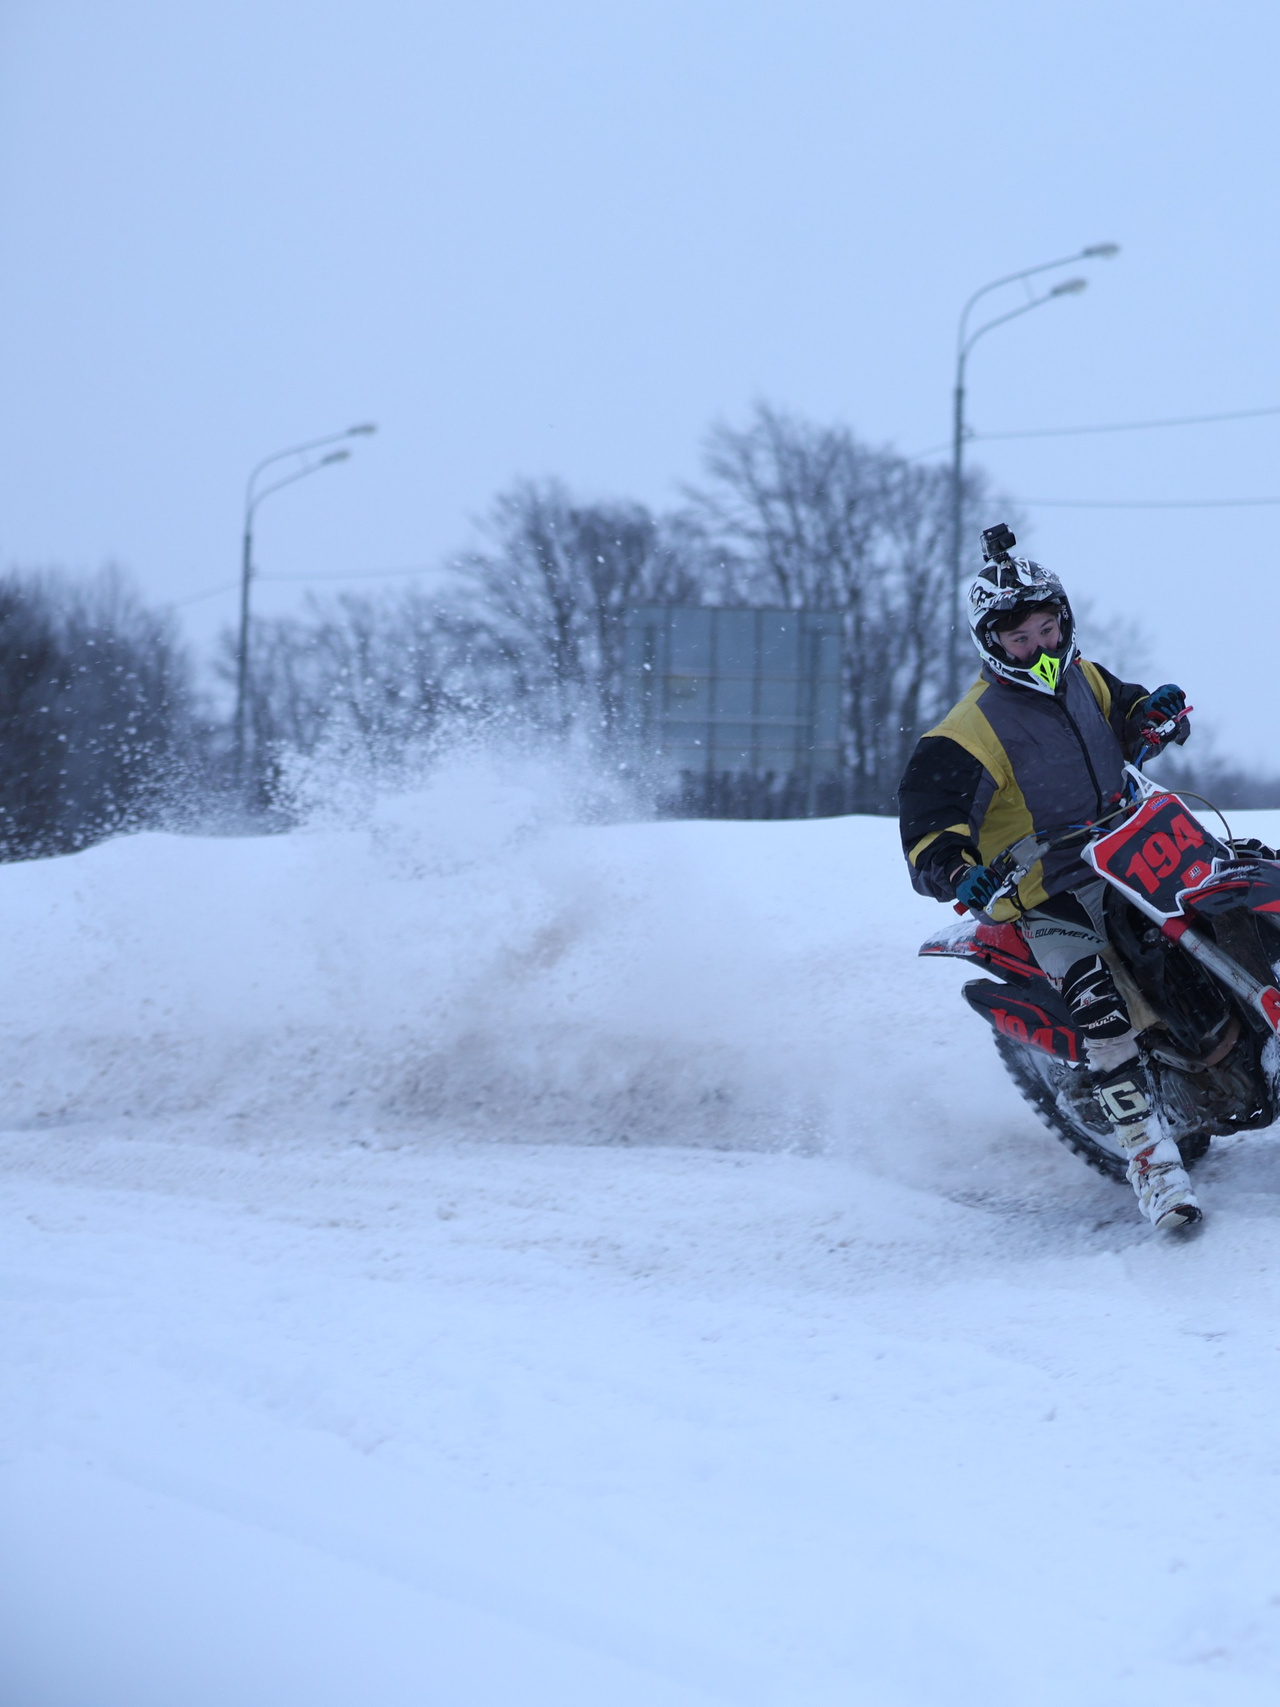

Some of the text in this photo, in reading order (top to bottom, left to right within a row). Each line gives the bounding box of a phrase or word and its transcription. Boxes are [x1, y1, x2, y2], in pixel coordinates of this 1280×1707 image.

[1125, 813, 1206, 895] 194
[1035, 927, 1105, 944] EQUIPMENT
[990, 1008, 1056, 1055] 194
[1088, 1015, 1117, 1030] BULL
